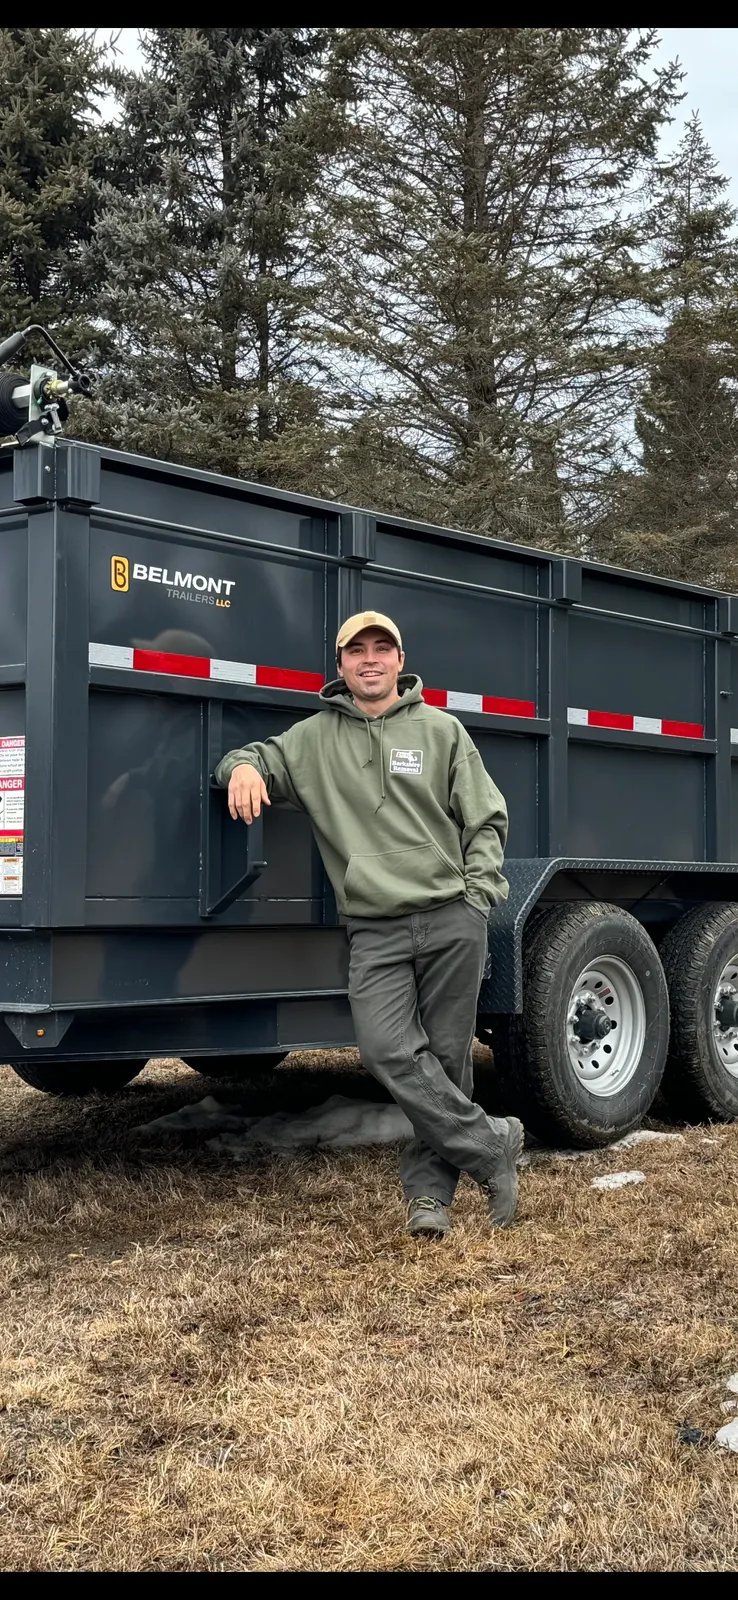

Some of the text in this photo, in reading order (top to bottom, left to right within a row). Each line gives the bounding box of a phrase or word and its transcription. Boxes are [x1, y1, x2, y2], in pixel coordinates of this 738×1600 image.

[132, 563, 236, 595] BELMONT
[166, 588, 231, 608] TRAILERS LLC
[1, 739, 25, 747] DANGER
[392, 760, 420, 768] Berkshire
[0, 779, 23, 789] ANGER
